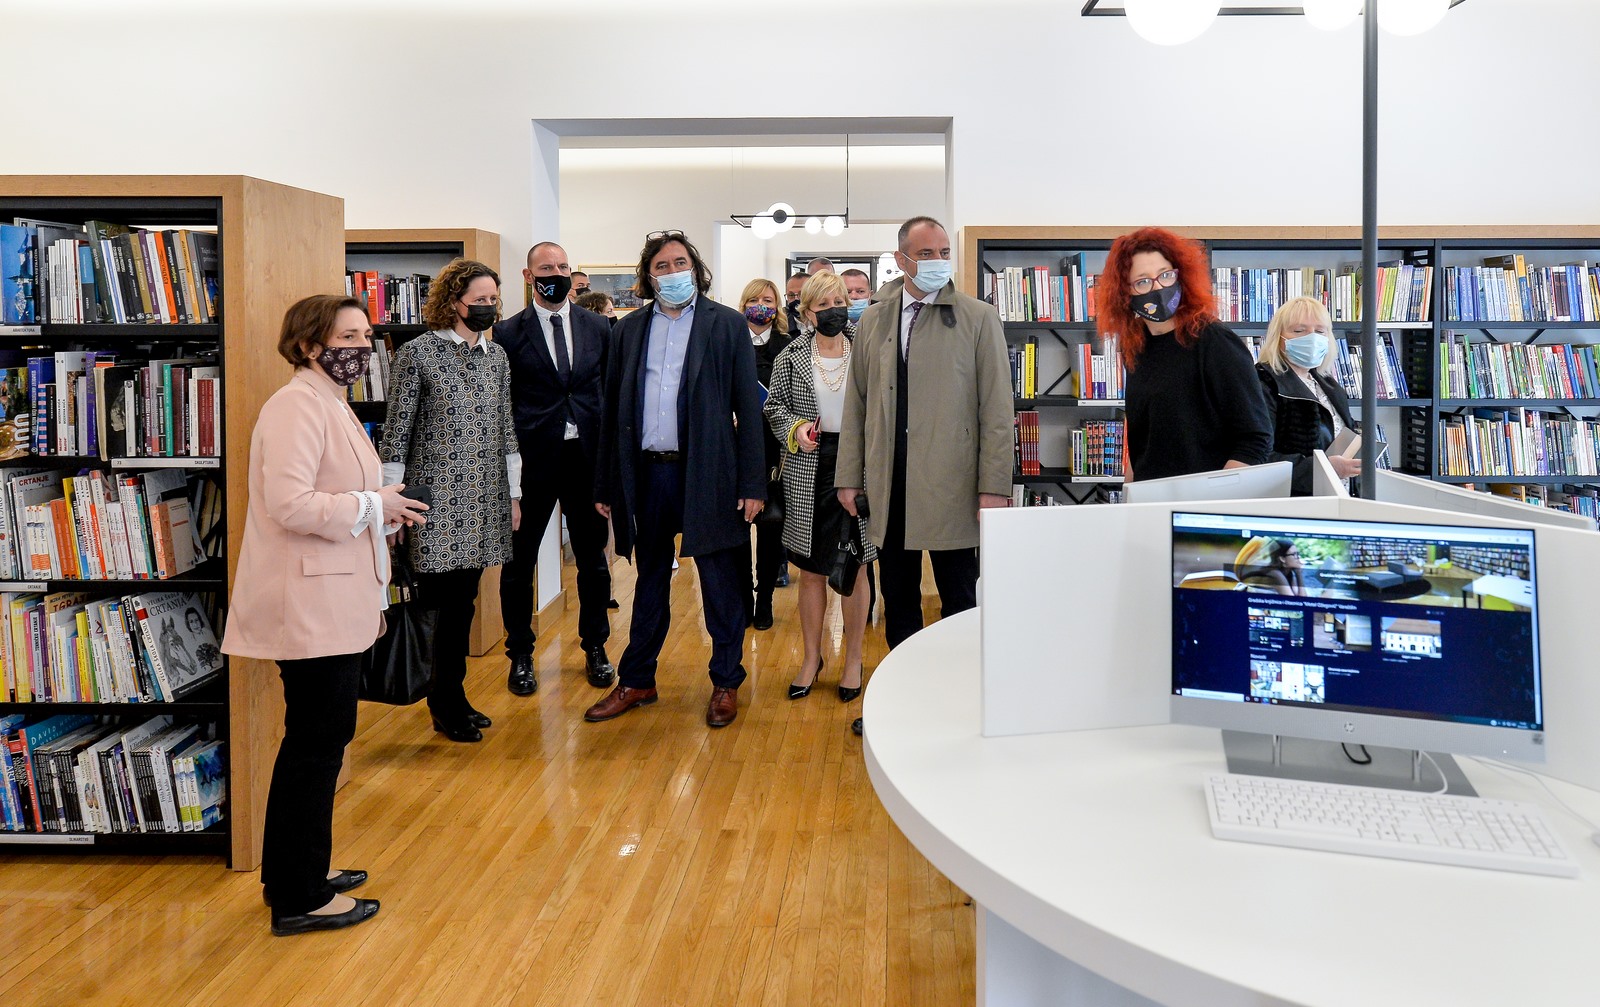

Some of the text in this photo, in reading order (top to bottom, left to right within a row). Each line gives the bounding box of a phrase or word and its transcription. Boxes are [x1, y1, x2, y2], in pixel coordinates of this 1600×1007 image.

[19, 475, 49, 486] CRTANJE
[147, 597, 164, 605] VELIKA
[150, 597, 187, 616] CRTANJA
[31, 726, 56, 745] DAVID
[5, 765, 16, 782] ART
